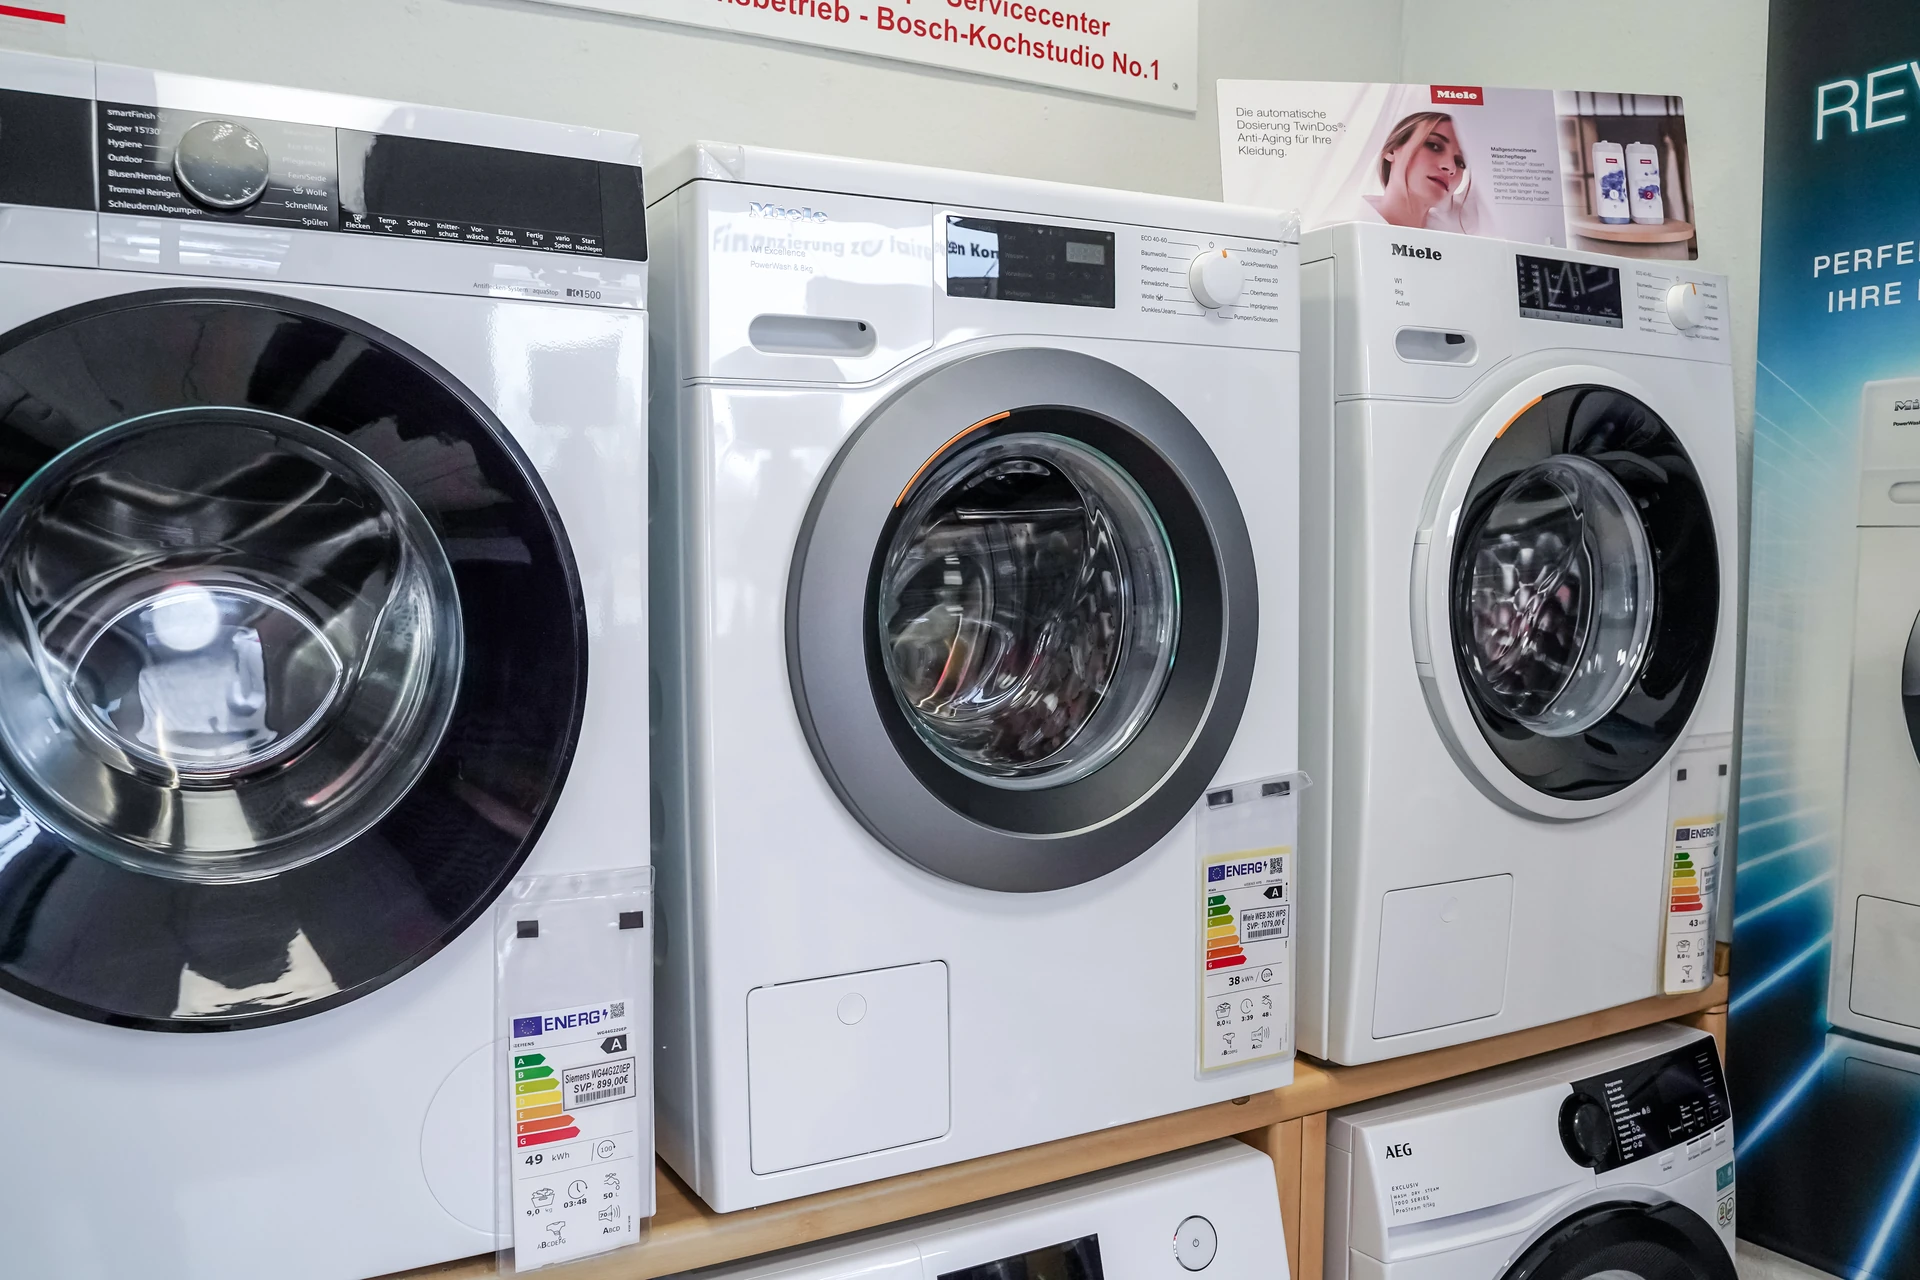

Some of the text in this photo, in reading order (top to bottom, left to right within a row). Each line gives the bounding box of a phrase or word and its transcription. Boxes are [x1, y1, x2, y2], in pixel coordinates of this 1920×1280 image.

[877, 6, 1104, 70] Bosch-Kochstudio
[1112, 51, 1159, 80] No.1
[1436, 90, 1477, 100] Miele
[1816, 61, 1920, 141] RE
[107, 109, 155, 119] smartFinish
[1236, 107, 1327, 119] Die automatische
[107, 123, 132, 133] Super
[1236, 120, 1291, 133] Dosierung
[107, 138, 143, 149] Hygiene
[1237, 133, 1332, 146] Anti-Aging für Ihre
[1238, 145, 1287, 158] Kleidung.
[107, 153, 143, 163] Outdoor
[107, 169, 171, 182] Blusen/Hemden
[288, 171, 327, 182] Fein/Seide
[108, 185, 181, 198] Trommel Reinigen
[305, 188, 327, 197] Wolle
[108, 200, 202, 215] Schleudern/Abpumpen
[285, 200, 328, 212] Schnell/Mix
[749, 201, 829, 223] Miele
[302, 217, 328, 227] Spülen
[345, 221, 370, 230] Flecken
[378, 216, 398, 225] Temp.
[407, 219, 430, 228] Schleu-
[436, 223, 460, 231] Knitter-
[470, 226, 484, 234] Vor-
[438, 231, 459, 239] schutz
[466, 233, 489, 241] wäsche
[495, 235, 516, 244] Spülen
[526, 231, 544, 240] Fertig
[554, 241, 572, 250] Speed
[581, 237, 596, 245] Start
[575, 244, 603, 253] Nachlegen
[750, 245, 806, 258] W1 Excellence
[1246, 247, 1272, 255] MobileStart
[1391, 243, 1442, 260] Miele
[1141, 250, 1167, 258] Baumwolle
[1813, 240, 1920, 278] PERFE
[750, 260, 792, 271] PowerWash
[800, 264, 814, 274] 8kg
[1141, 265, 1168, 273] Pflegeleicht
[1240, 260, 1278, 270] QuickPowerWash
[1141, 279, 1169, 287] Feinwäsche
[473, 282, 559, 296] Antiflecken-System aquaStop
[1828, 281, 1902, 313] IHRE
[1141, 306, 1176, 315] Dunkles/Jeans
[1249, 303, 1278, 311] Imprägnieren
[1234, 314, 1278, 323] Pumpen/Schleudern
[1894, 399, 1920, 411] Mi
[1226, 861, 1262, 877] ENERG
[1272, 888, 1279, 897] A
[1275, 909, 1286, 917] WPS
[1246, 922, 1259, 930] SVP:
[1261, 920, 1280, 928] 1079,00
[1689, 919, 1698, 927] 43
[1228, 976, 1240, 986] 38
[544, 1010, 600, 1031] ENERG
[611, 1038, 622, 1051] A
[565, 1072, 590, 1084] Siemens
[573, 1074, 629, 1093] SVP: 899,00€
[525, 1145, 613, 1166] 49 kWh 100
[1385, 1142, 1412, 1159] AEG
[1391, 1182, 1419, 1192] EXCLUSIV
[603, 1192, 613, 1200] 50
[1410, 1195, 1429, 1204] SERIES
[563, 1198, 587, 1209] 03:48
[526, 1208, 540, 1217] 9,0
[1395, 1205, 1421, 1213] ProSteam
[602, 1225, 621, 1235] ABCD
[537, 1239, 566, 1249] ABCDEFG
